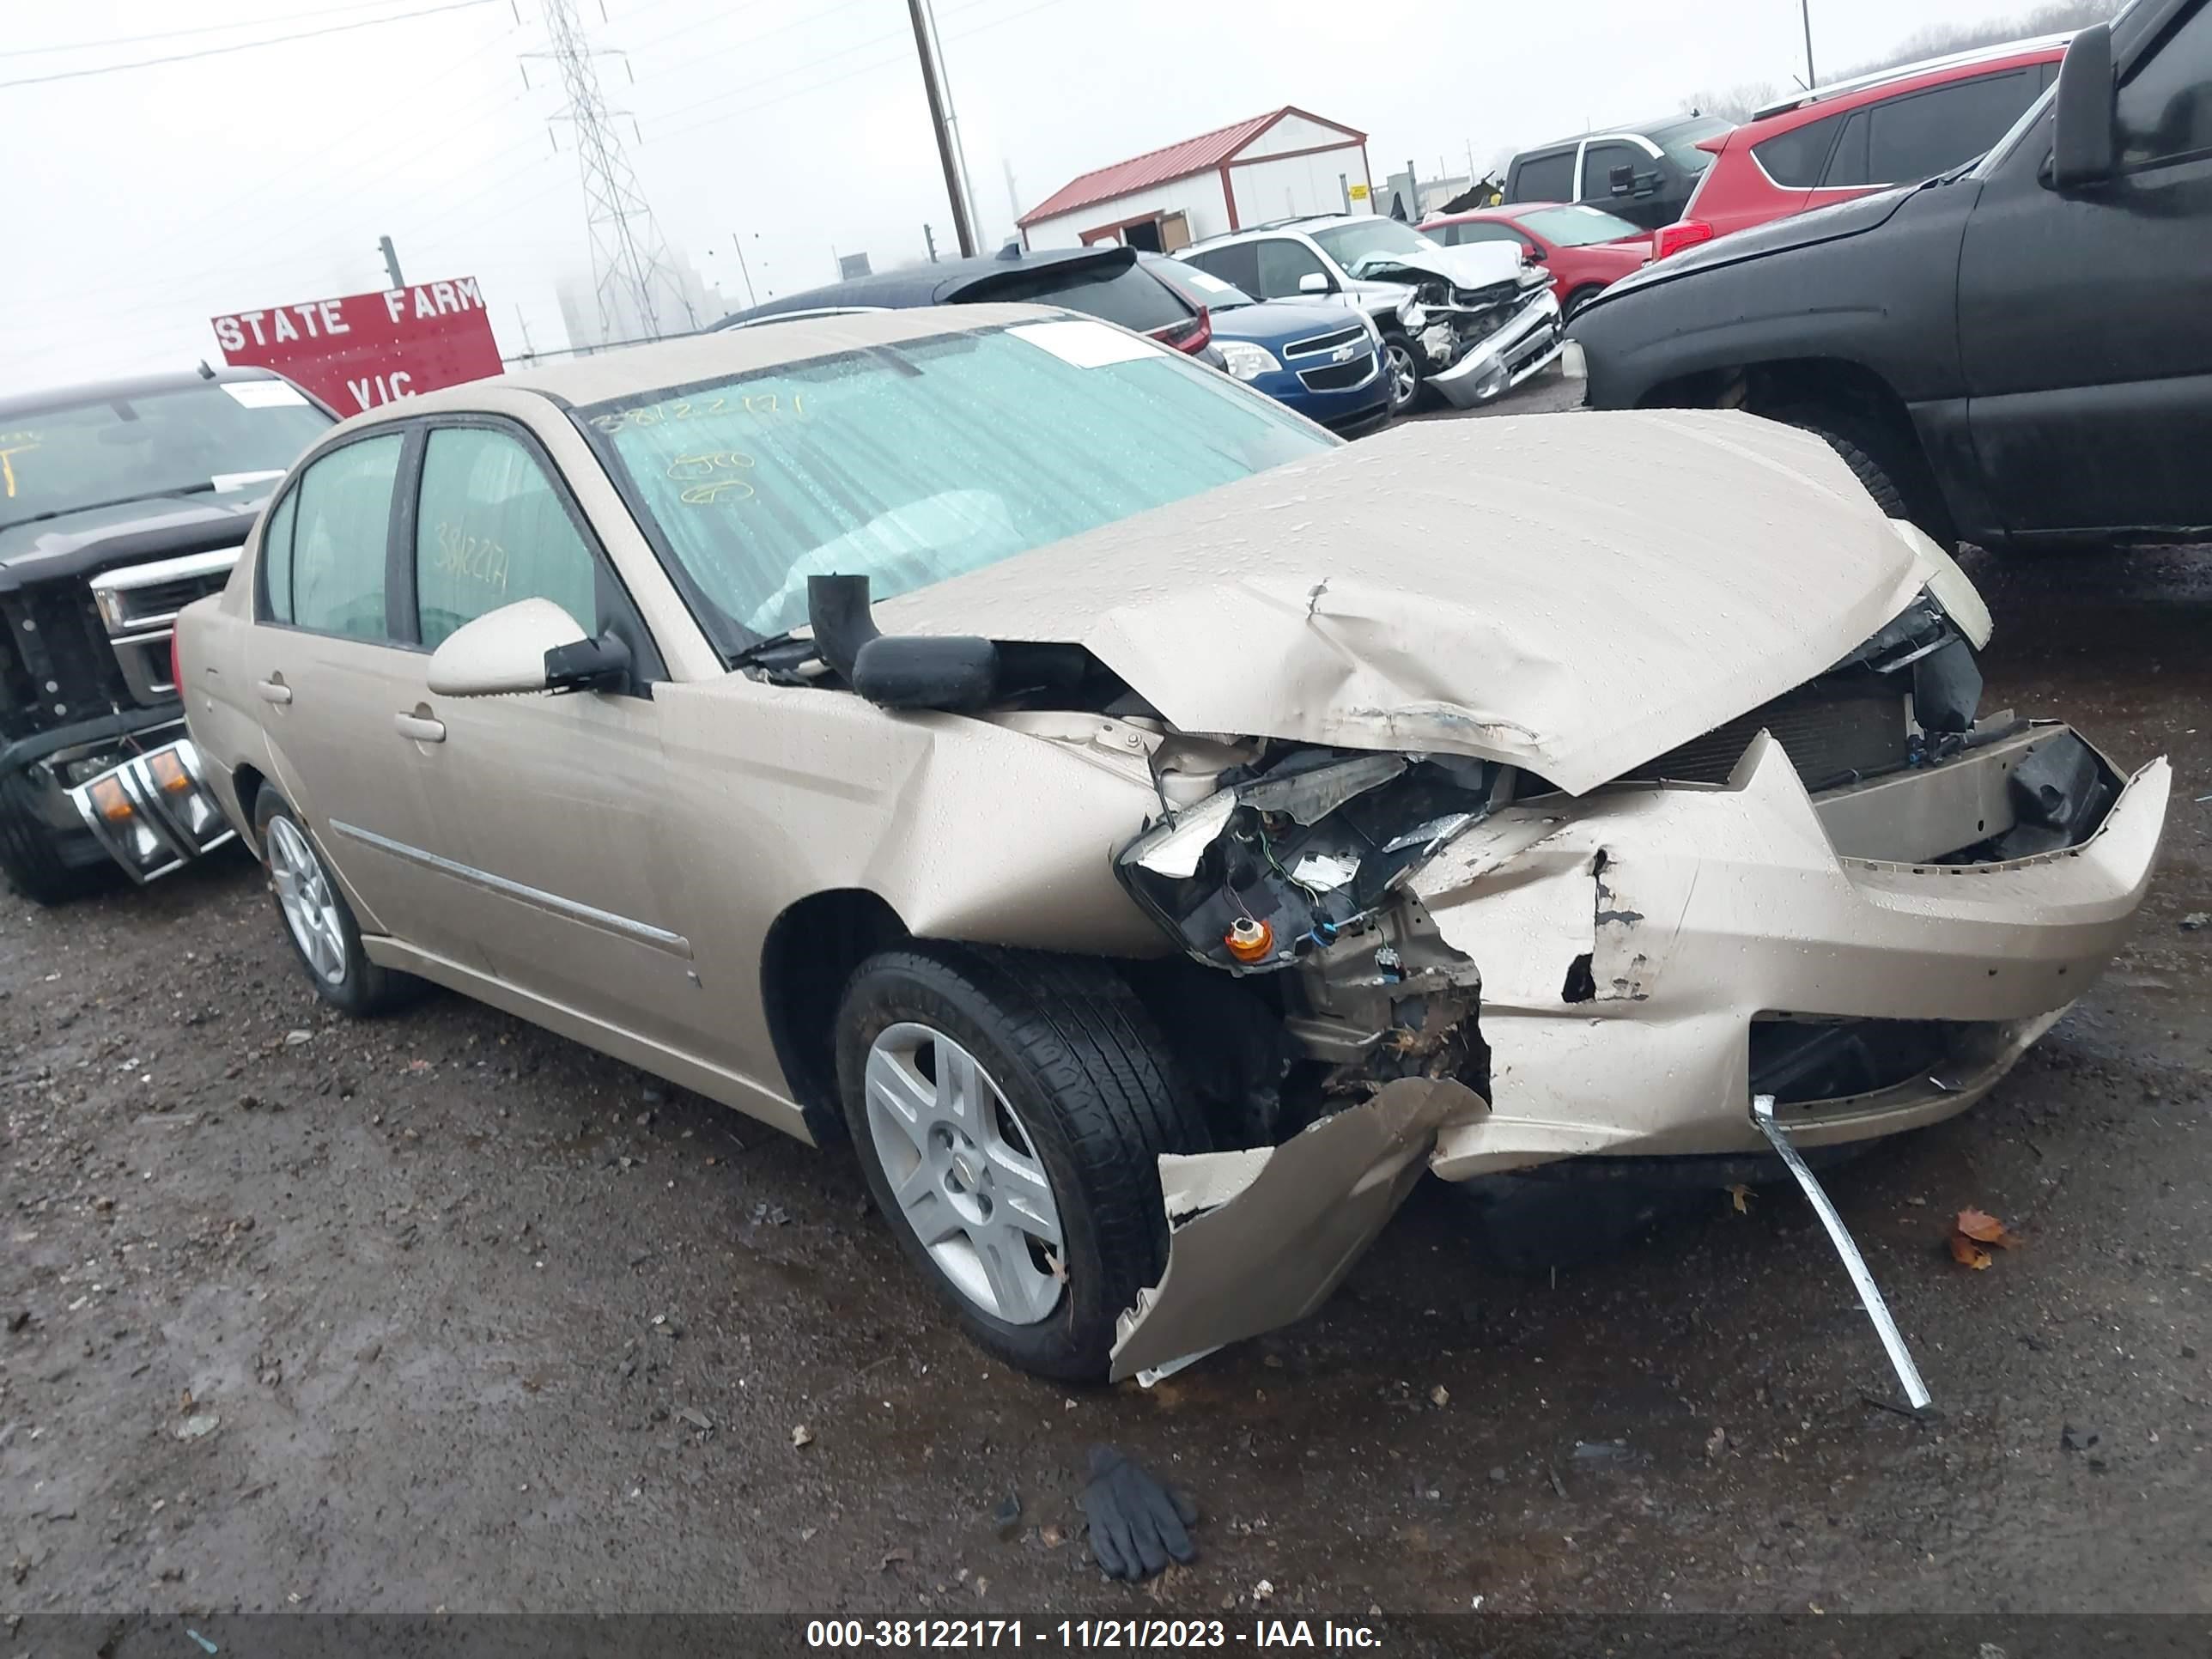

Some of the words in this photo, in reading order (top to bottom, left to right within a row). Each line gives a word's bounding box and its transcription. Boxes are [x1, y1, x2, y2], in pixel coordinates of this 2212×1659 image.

[215, 301, 349, 351] STATE
[384, 278, 484, 324] FARM
[347, 371, 416, 412] VIC
[589, 394, 803, 433] 38122171
